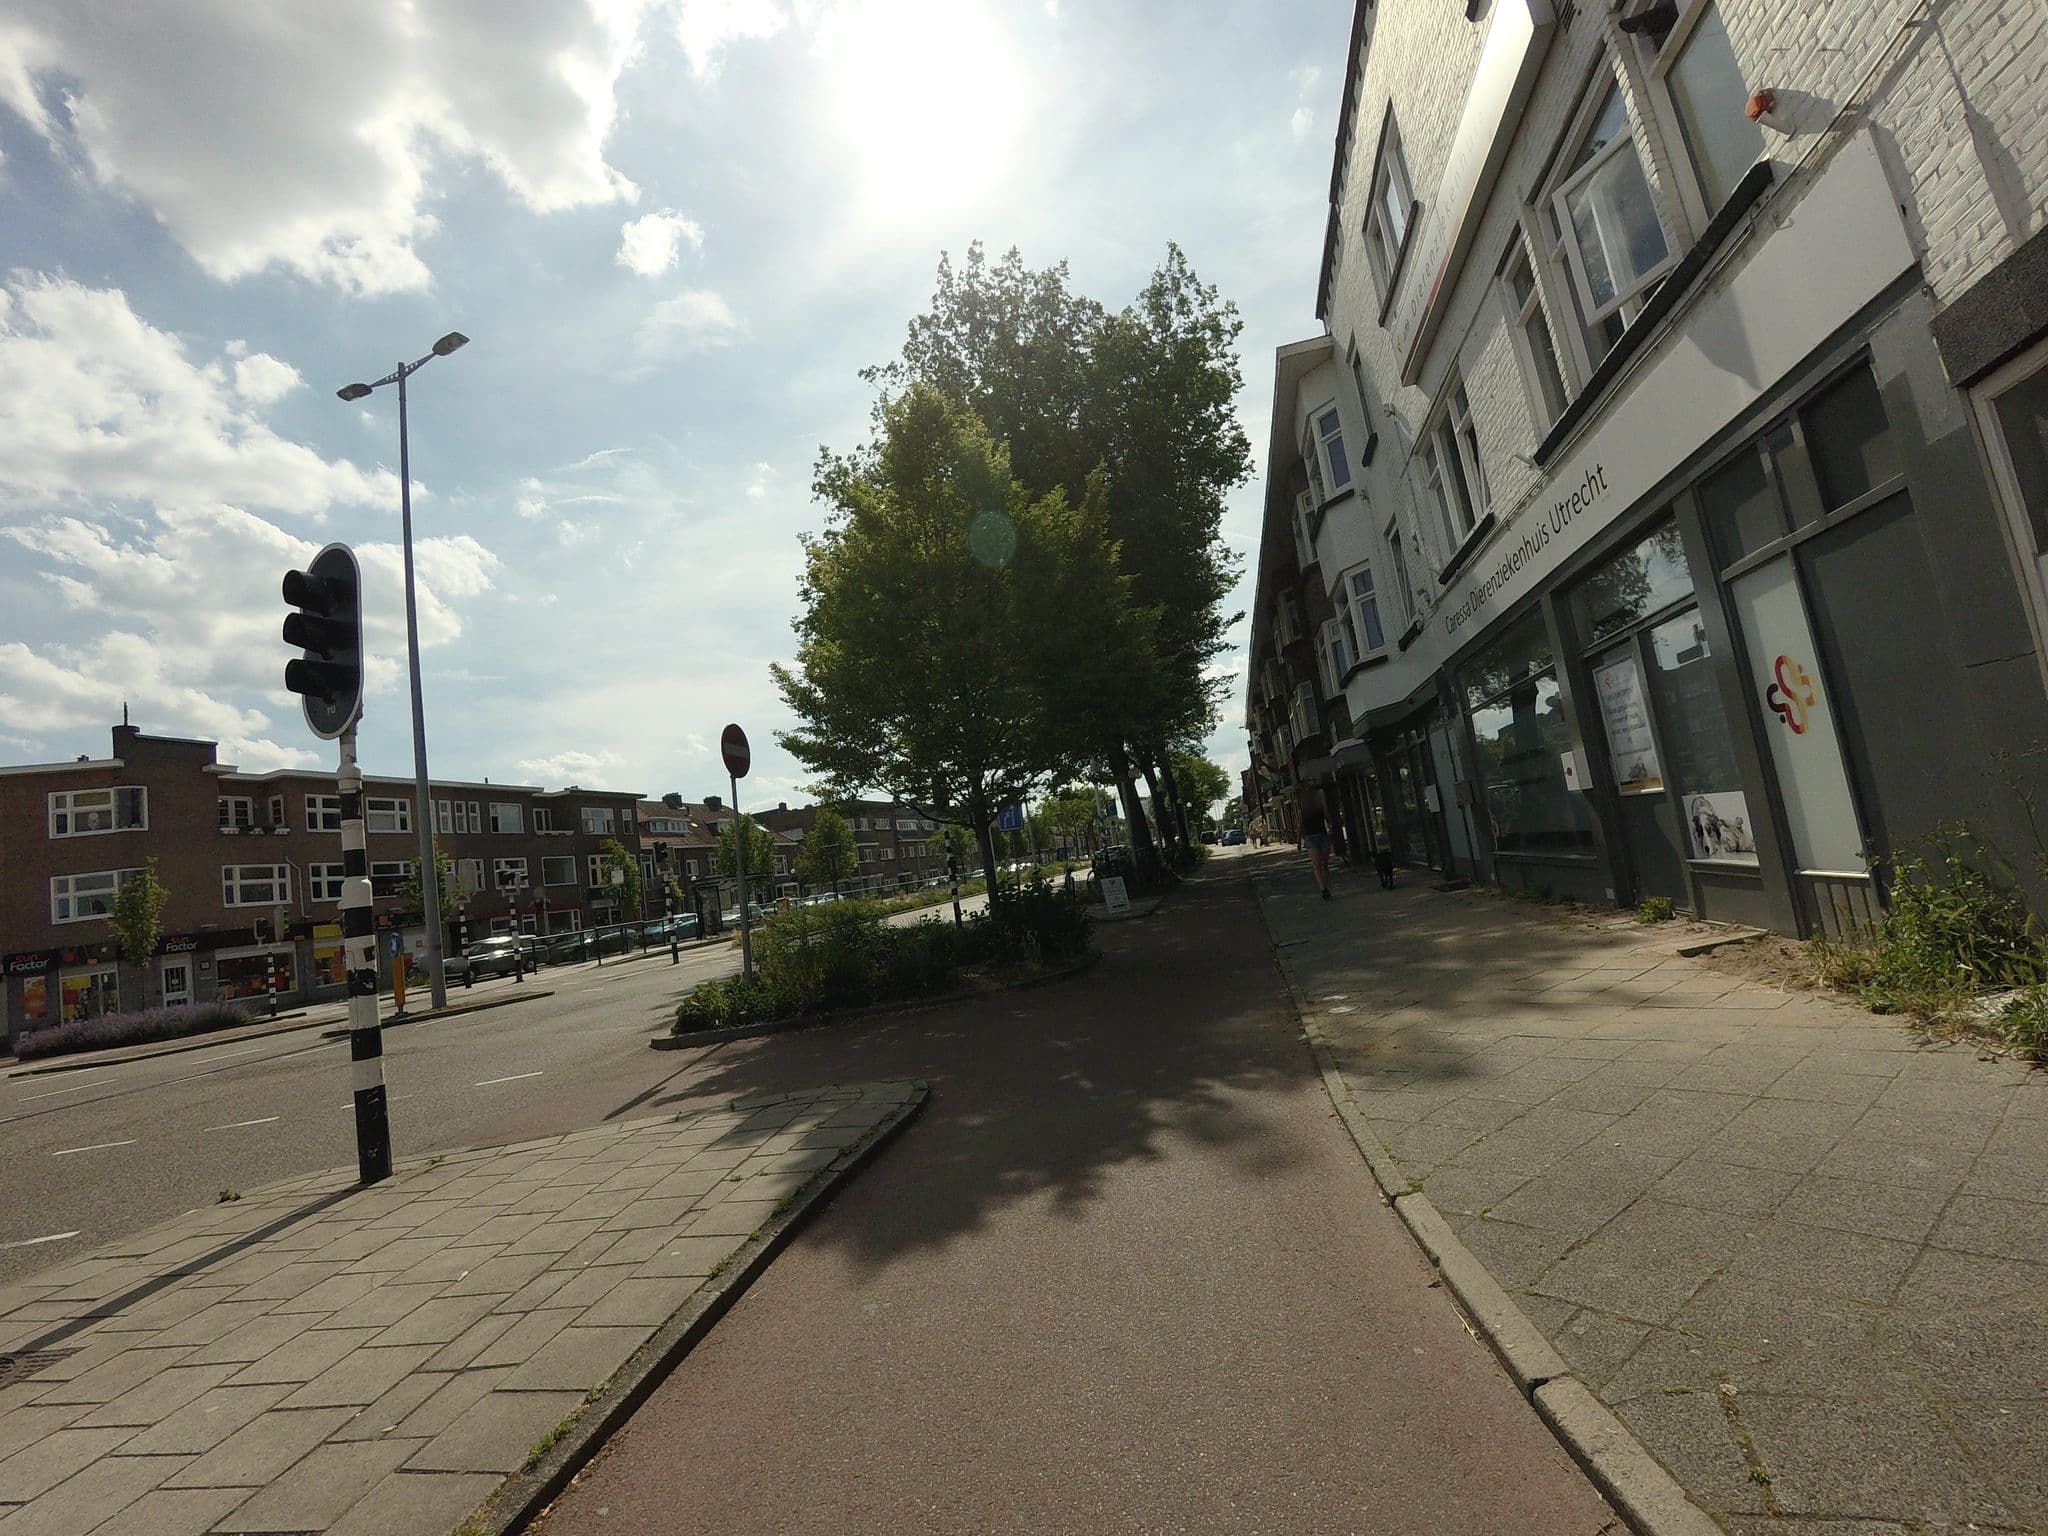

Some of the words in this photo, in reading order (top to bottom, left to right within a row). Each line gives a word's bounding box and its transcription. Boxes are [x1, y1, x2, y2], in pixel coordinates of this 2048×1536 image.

[1469, 520, 1550, 612] Dierenziekenhuis
[1548, 463, 1608, 535] Utrecht
[10, 958, 49, 972] Factor
